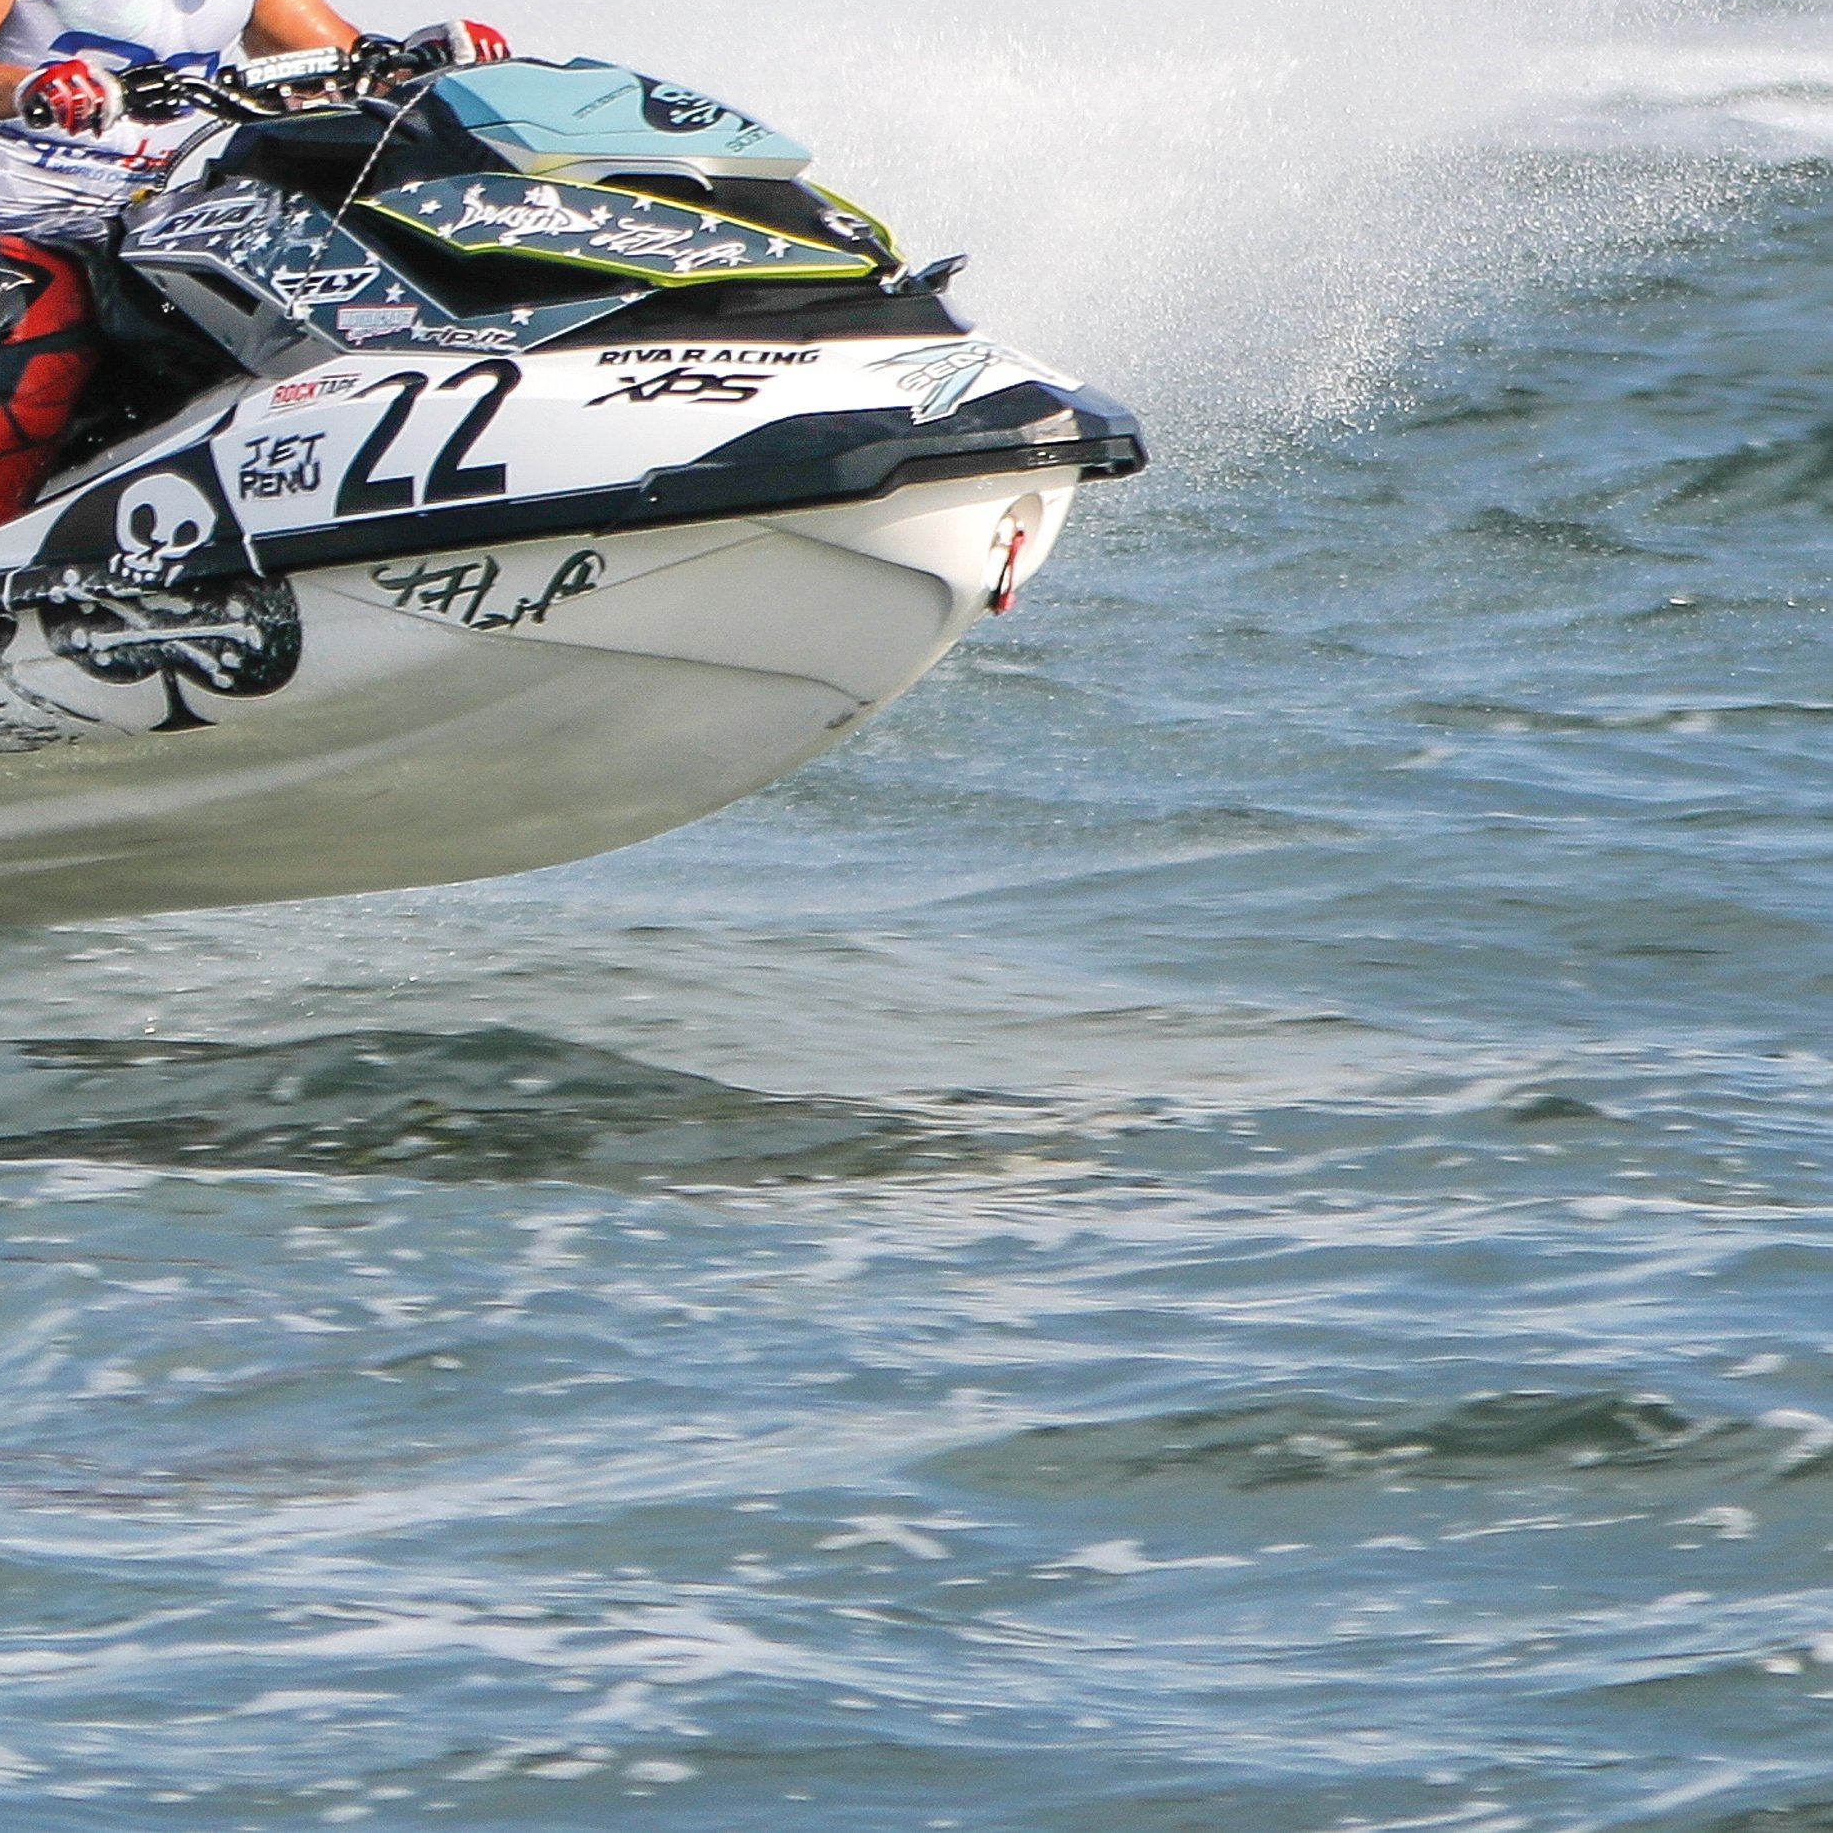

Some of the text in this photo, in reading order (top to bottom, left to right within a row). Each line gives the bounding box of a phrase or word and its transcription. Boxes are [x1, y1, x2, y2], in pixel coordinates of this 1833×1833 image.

[595, 348, 821, 366] RIVA RACING
[583, 366, 778, 408] XPS
[244, 431, 326, 466] JET
[334, 358, 523, 517] 22
[239, 461, 321, 499] RENU
